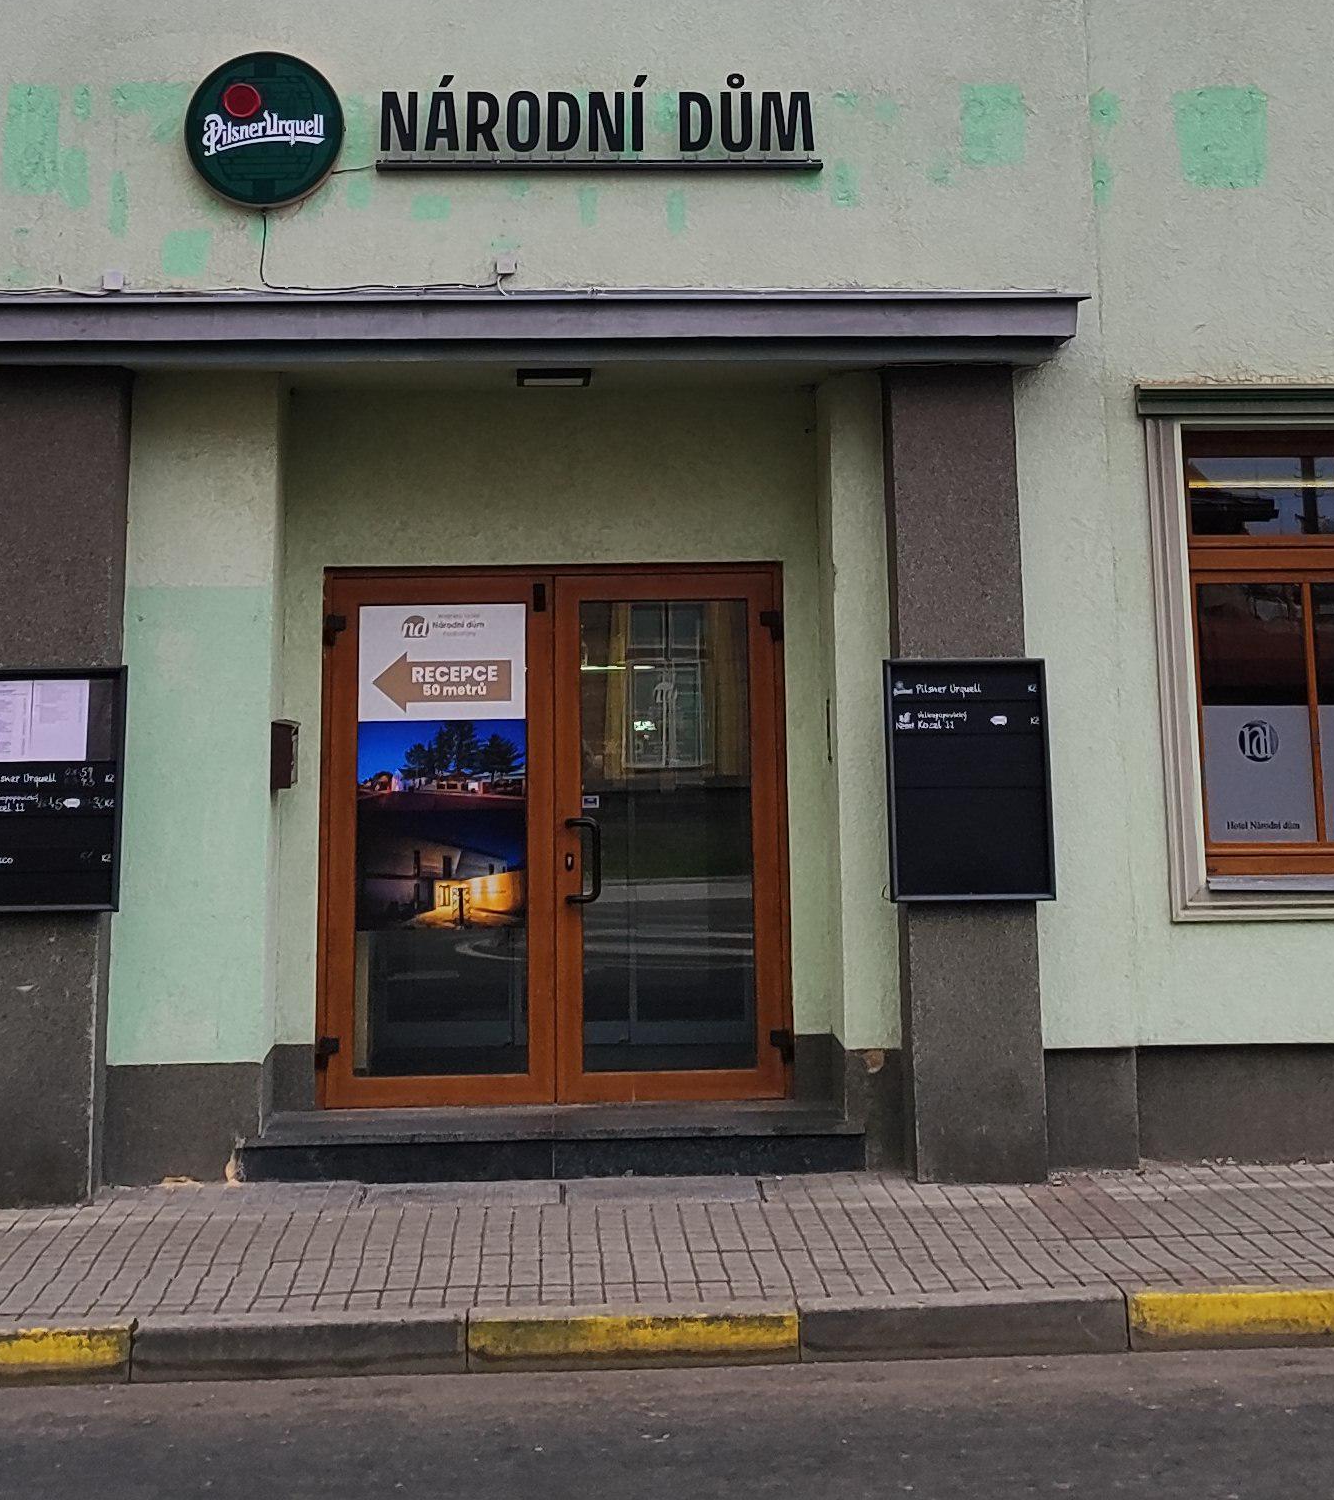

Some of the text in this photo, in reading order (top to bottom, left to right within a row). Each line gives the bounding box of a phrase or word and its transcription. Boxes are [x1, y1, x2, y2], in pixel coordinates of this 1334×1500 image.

[379, 73, 815, 153] NÁRODNÍ DŮM
[202, 110, 325, 157] Pilsner Urquell
[411, 665, 498, 684] RECEPCE
[423, 682, 487, 696] 50 metrů
[916, 683, 947, 694] Pilsner
[949, 683, 981, 698] Urquell
[23, 773, 56, 787] Urquell
[1226, 820, 1300, 830] Hotel Národní dům
